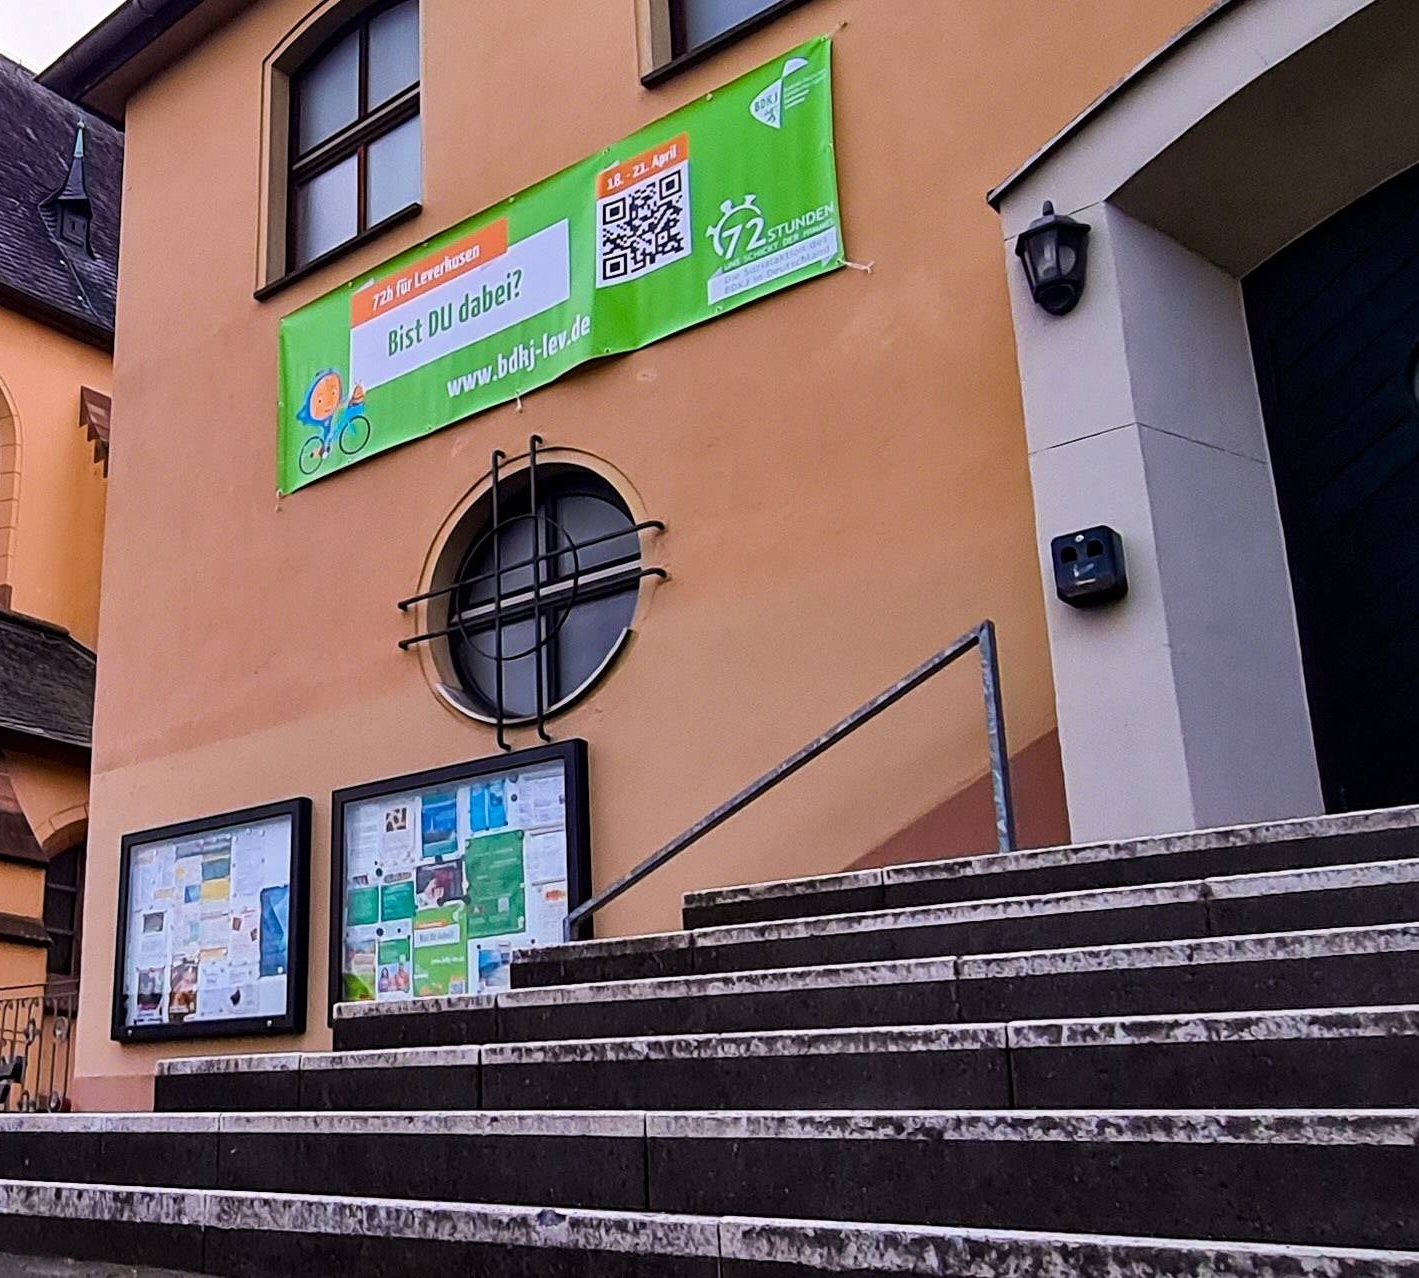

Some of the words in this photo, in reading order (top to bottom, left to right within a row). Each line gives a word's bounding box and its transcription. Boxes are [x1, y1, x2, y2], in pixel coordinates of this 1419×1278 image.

[607, 174, 623, 191] 18.
[632, 160, 649, 177] 21.
[652, 143, 678, 168] April
[721, 217, 766, 260] 72
[767, 201, 835, 242] STUNDEN
[372, 285, 393, 311] 72h
[396, 277, 412, 297] für
[414, 245, 480, 288] Leverkusen
[388, 318, 423, 356] Bist
[429, 302, 452, 338] DU
[459, 268, 522, 323] dabei?
[446, 313, 591, 398] www.bdkj-lev.de
